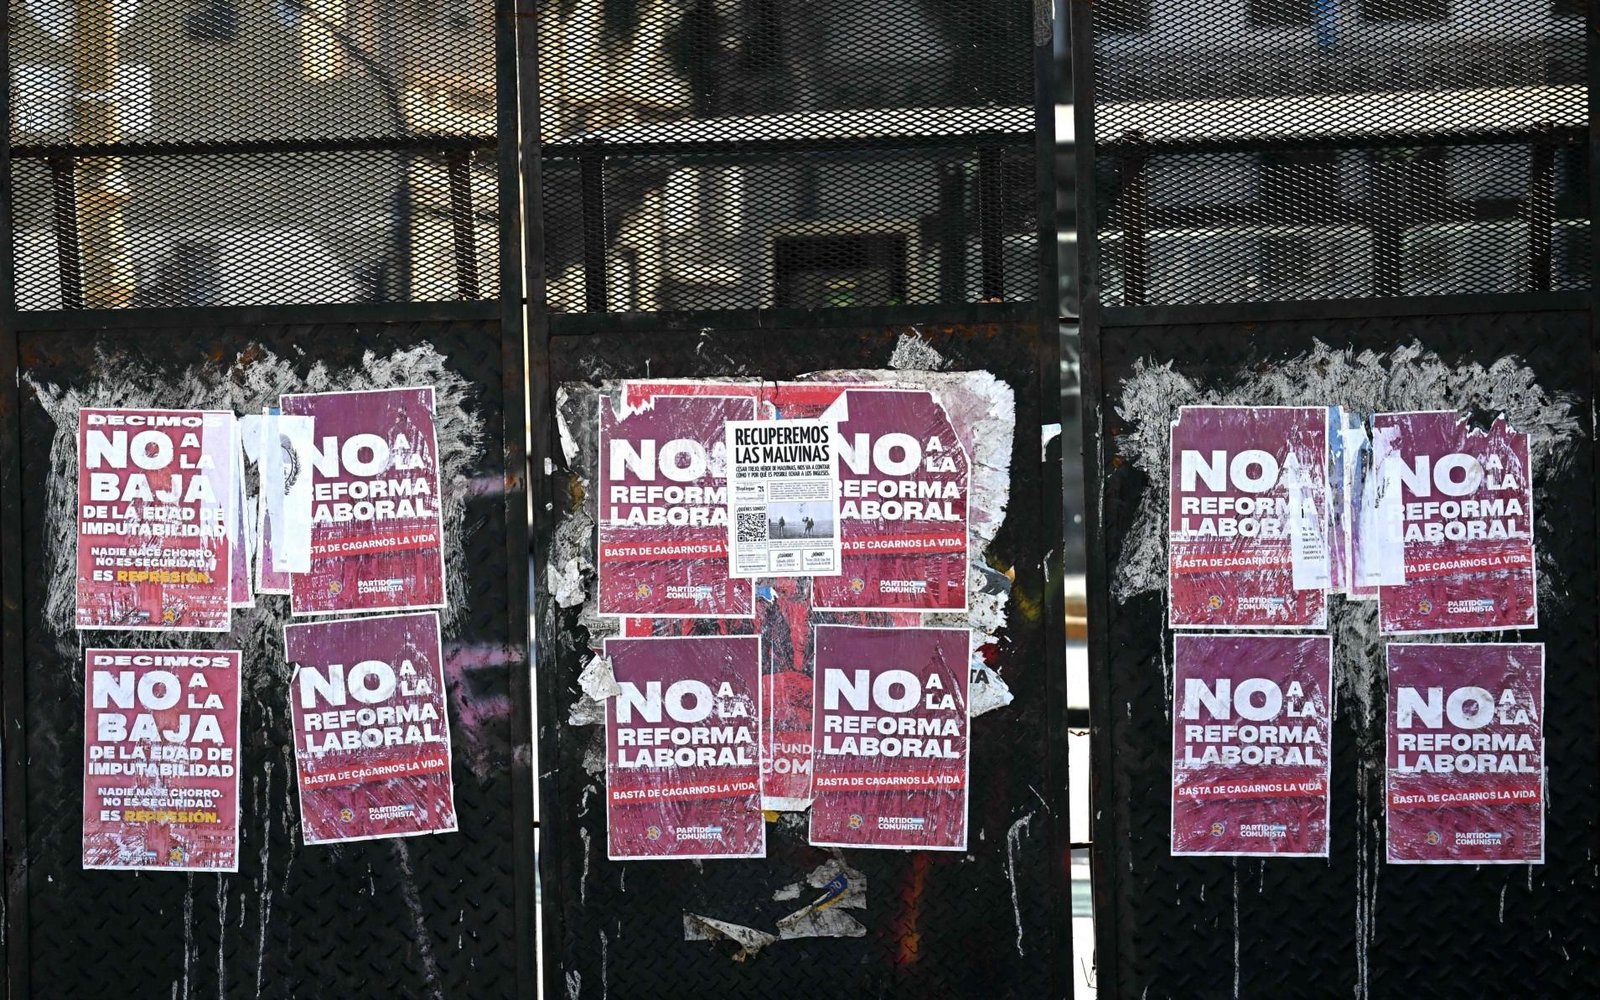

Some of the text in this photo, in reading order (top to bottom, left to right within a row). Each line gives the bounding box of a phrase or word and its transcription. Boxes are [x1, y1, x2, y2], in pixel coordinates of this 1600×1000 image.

[87, 415, 223, 427] DECIMOS
[735, 426, 829, 445] RECUPEREMOS
[86, 430, 200, 470] NO A
[312, 434, 410, 478] NO A
[736, 445, 829, 463] LAS MALVINAS
[838, 433, 943, 476] NO A
[180, 454, 215, 469] LA
[396, 454, 425, 470] LA
[610, 439, 707, 482] NO
[926, 457, 957, 472] LA
[1181, 450, 1278, 493] NO
[1401, 453, 1503, 497] NO A
[90, 473, 217, 503] BAJA
[312, 478, 431, 501] EFORMA
[837, 480, 961, 499] EFORMA
[1487, 474, 1519, 490] LA
[610, 486, 726, 504] REFORM
[83, 506, 224, 521] DE LA EDAD DE
[312, 500, 434, 523] ABORAL
[840, 501, 960, 521] ABORAL
[82, 522, 226, 537] IMPUTABILIDAD
[91, 548, 160, 556] NADIE NACE
[328, 534, 435, 553] DE CAGARNOS LA VIDA
[605, 548, 637, 557] BASTA
[640, 547, 652, 555] DE
[655, 546, 707, 555] CAGARNOS
[854, 541, 865, 549] DE
[867, 539, 921, 548] CAGARNOS
[923, 539, 936, 547] LA
[938, 538, 961, 547] VIDA
[96, 558, 114, 566] NO
[1176, 559, 1208, 568] BASTA
[1225, 557, 1279, 566] CAGARNOS
[1419, 563, 1430, 572] DE
[1433, 559, 1487, 570] CAGARNOS
[1489, 557, 1501, 565] LA
[1504, 555, 1526, 563] VIDA
[93, 571, 113, 581] ES
[358, 579, 392, 587] PARTIDO
[358, 585, 403, 594] COMUNISTA
[94, 656, 230, 668] DECIMOS
[93, 671, 208, 710] NO A
[299, 660, 416, 709] NO A
[401, 679, 432, 696] LA
[824, 669, 943, 712] NO A
[188, 694, 223, 709] LA
[616, 680, 734, 723] NO A
[926, 694, 956, 710] LA
[1184, 678, 1304, 721] NO A
[1397, 687, 1517, 729] NO A
[304, 703, 439, 732] REFORMA
[719, 702, 747, 717] LA
[1287, 701, 1317, 717] LA
[1501, 709, 1530, 725] LA
[98, 713, 224, 743] BAJA
[824, 716, 960, 736] REFORMA
[1185, 725, 1321, 743] REFORMA
[306, 725, 441, 754] LABORAL
[618, 727, 752, 745] REFORMA
[1398, 734, 1535, 751] REFORMA
[90, 746, 232, 761] DE LA EDAD DE
[824, 736, 959, 758] LABORAL
[618, 747, 752, 768] LABORAL
[1185, 746, 1321, 766] LABORAL
[1398, 754, 1535, 773] LABORAL
[89, 763, 234, 777] IMPUTABILIDAD
[304, 759, 444, 785] BASTA DE CAGARNOS LA VIDA
[817, 777, 849, 786] BASTA
[852, 777, 863, 785] DE
[866, 777, 919, 785] CAGARNOS
[922, 776, 934, 784] LA
[1179, 782, 1322, 795] BASTA DE CAGARNOS LA VIDA
[98, 788, 223, 798] NADIE NACE CHORRO.
[613, 782, 755, 799] BASTA DE CAGARNOS LA VIDA
[1393, 790, 1536, 804] BASTA DE CAGARNOS LA VIDA
[103, 798, 121, 806] NO
[141, 799, 216, 807] SEGURIDAD.
[369, 805, 405, 814] PARTIDO
[101, 811, 120, 821] ES
[370, 811, 415, 819] COMUNISTA
